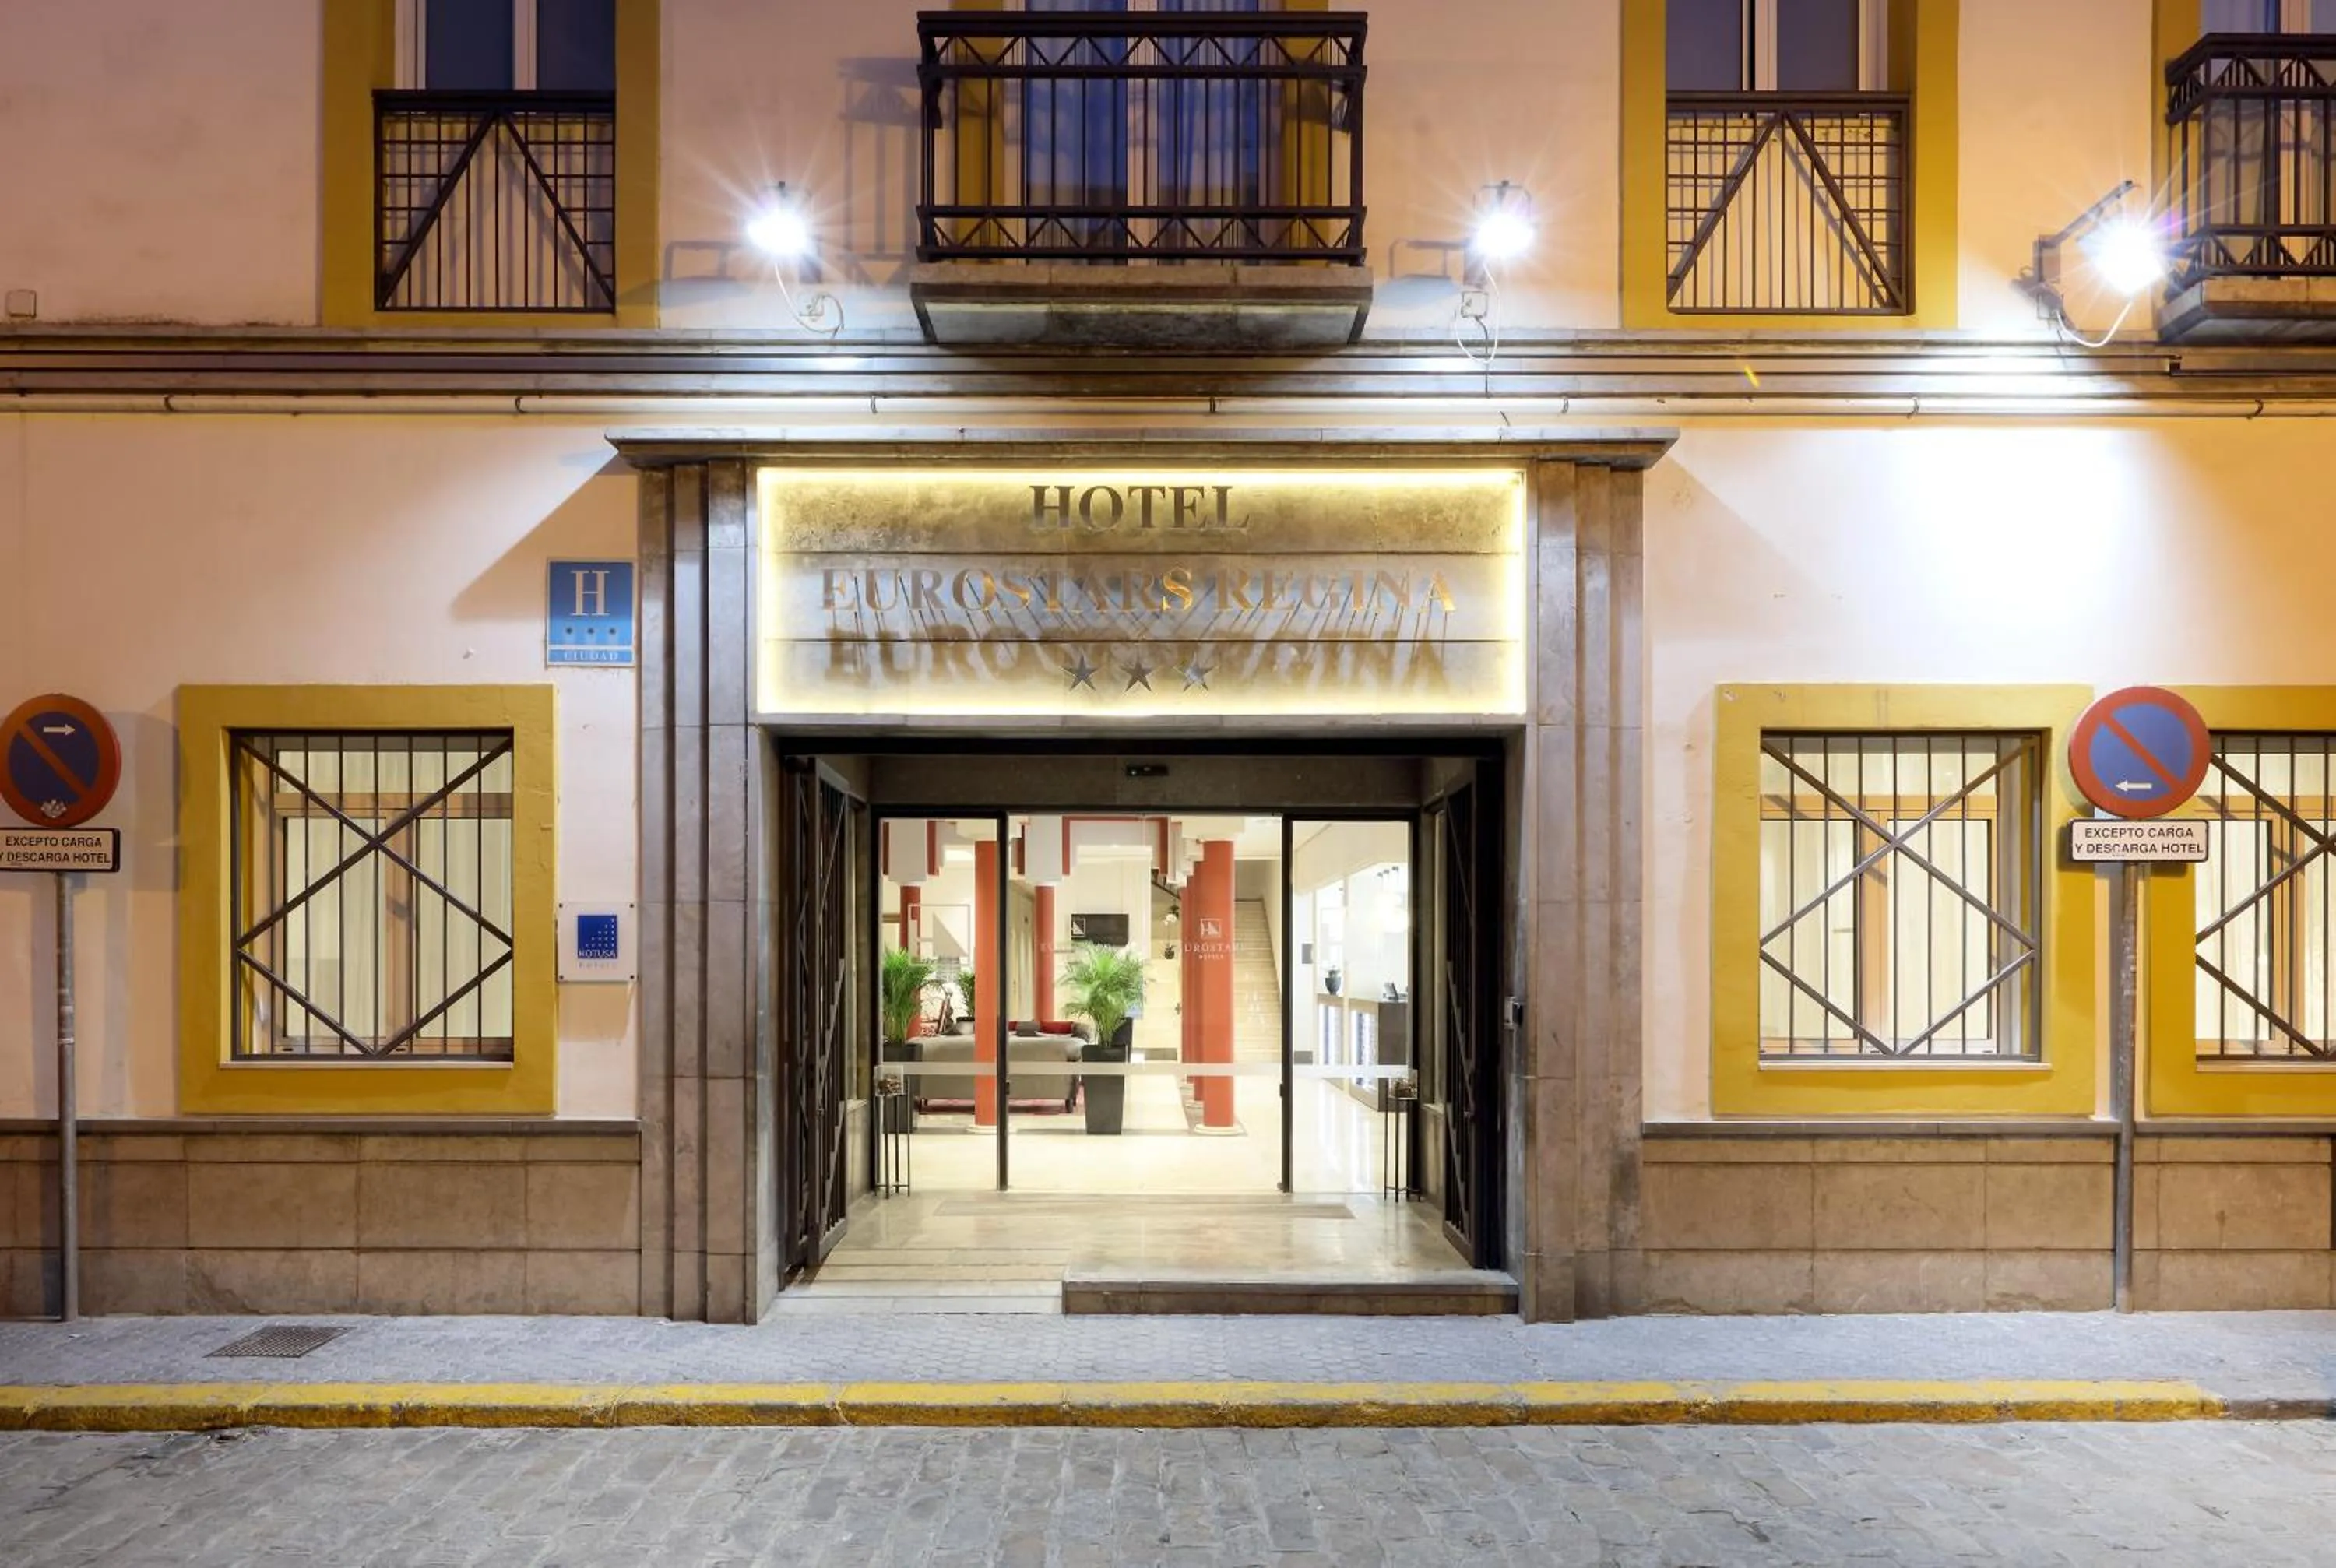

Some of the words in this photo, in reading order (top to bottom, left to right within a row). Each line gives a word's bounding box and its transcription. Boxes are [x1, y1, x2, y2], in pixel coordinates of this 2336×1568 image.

[1029, 484, 1251, 529] HOTEL
[570, 570, 610, 616] H
[821, 567, 1194, 613] EUROSTARS
[1212, 565, 1456, 613] REGINA
[564, 651, 619, 661] CIUDAD
[2084, 828, 2144, 838] EXCEPTO
[2147, 828, 2194, 838] CARGA
[5, 835, 58, 847] EXCEPTO
[62, 836, 102, 847] CARGA
[2075, 844, 2083, 853] Y
[2087, 843, 2158, 854] DESCARGA
[2161, 843, 2204, 853] HOTEL
[6, 852, 70, 862] DESCARGA
[72, 853, 111, 863] HOTEL
